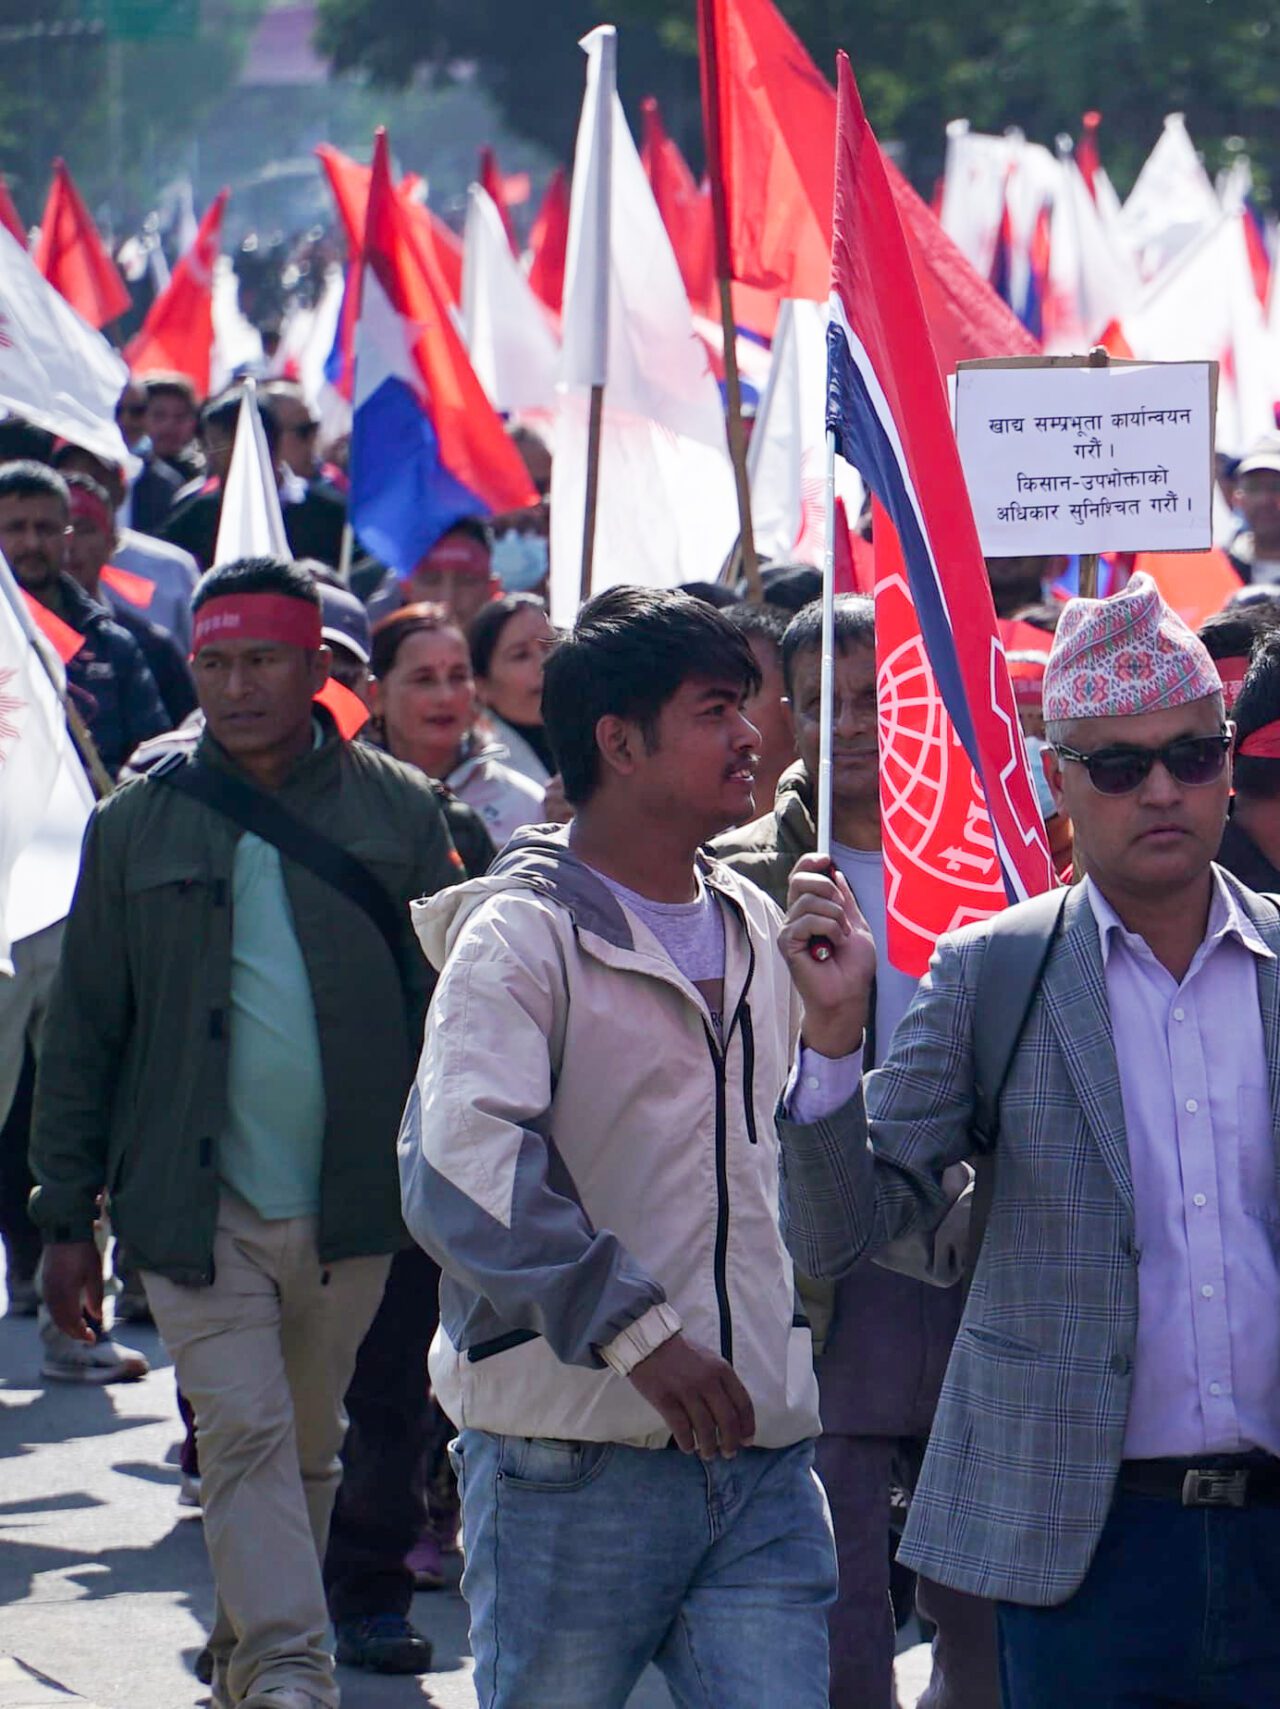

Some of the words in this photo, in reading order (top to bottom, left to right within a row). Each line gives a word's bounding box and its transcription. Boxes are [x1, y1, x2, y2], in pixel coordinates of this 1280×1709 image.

[988, 417, 1025, 433] खाद्य
[1111, 406, 1192, 430] कार्यान्वयन
[1017, 465, 1169, 493] किसान-उपभोक्ताको
[997, 501, 1060, 522] अधिकार
[1069, 497, 1141, 526] सुनिश्चित
